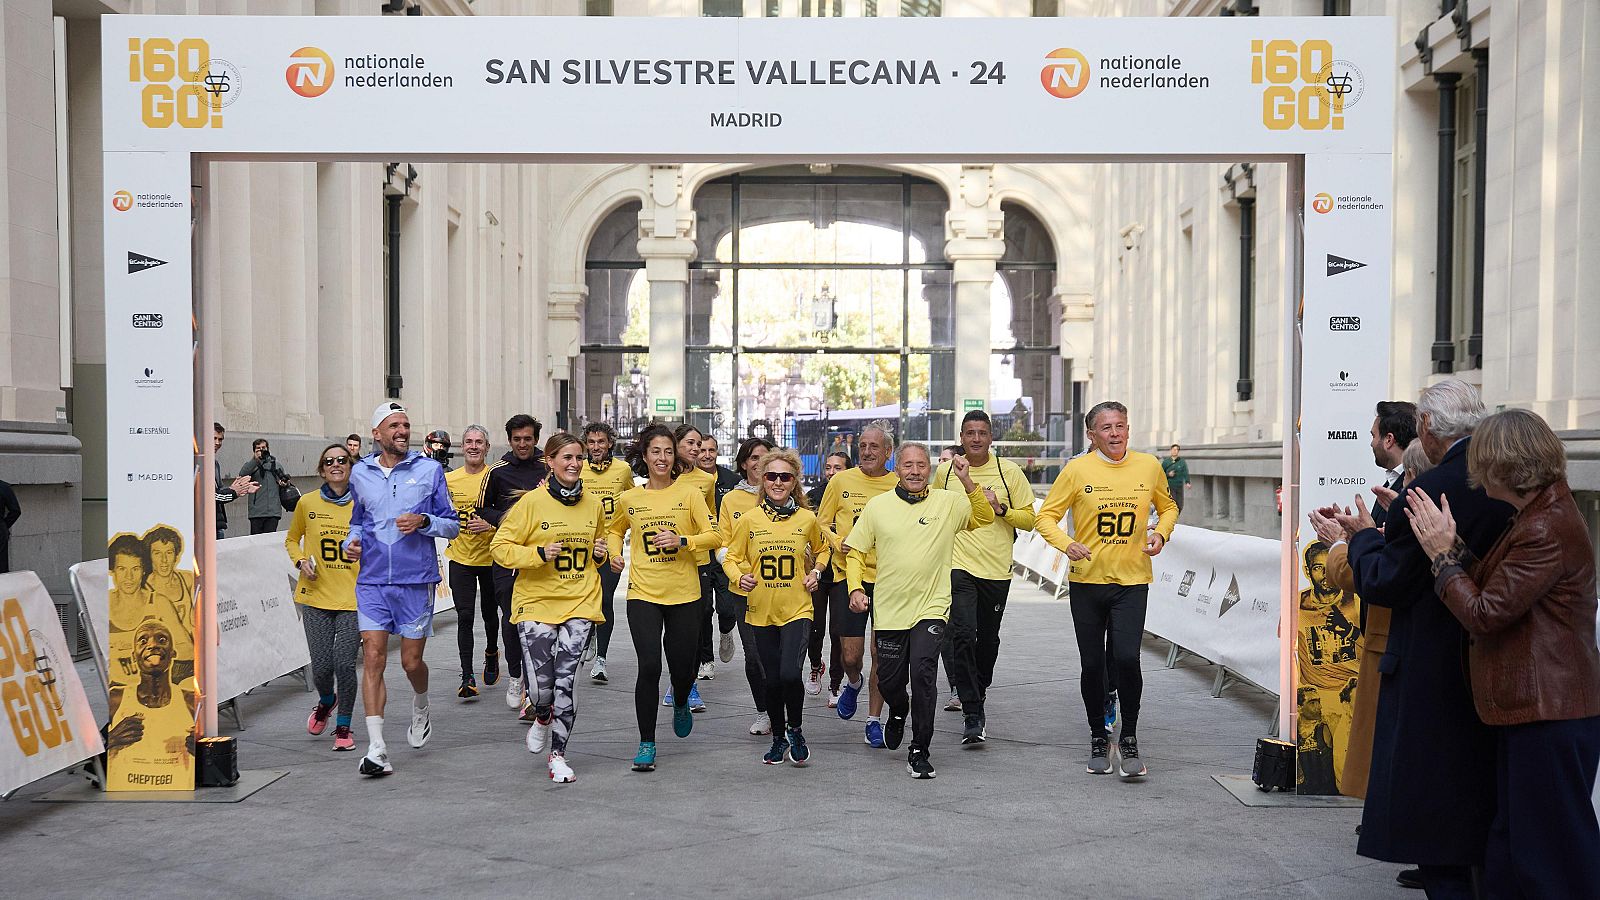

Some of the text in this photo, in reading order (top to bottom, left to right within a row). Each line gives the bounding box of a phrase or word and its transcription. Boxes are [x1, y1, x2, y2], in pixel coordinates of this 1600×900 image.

[345, 54, 424, 69] nationale
[1100, 55, 1181, 70] nationale
[484, 59, 551, 85] SAN
[562, 59, 737, 85] SILVESTRE
[746, 60, 941, 85] VALLECANA
[969, 61, 1007, 85] 24
[345, 72, 453, 88] nederlanden
[1100, 73, 1209, 88] nederlanden
[141, 83, 223, 128] GO!
[1262, 85, 1344, 130] GO!
[710, 112, 782, 128] MADRID
[129, 426, 170, 435] EL ESPAÑOL
[1328, 430, 1358, 440] MARCA
[138, 473, 173, 481] MADRID
[1330, 477, 1366, 485] MADRID
[1109, 501, 1138, 510] SILVESTRE
[1097, 511, 1136, 537] 60
[769, 545, 796, 554] SILVESTRE
[554, 547, 588, 572] 60
[760, 555, 795, 580] 60
[2, 674, 73, 757] GO!
[127, 772, 173, 785] CHEPTEGEI
